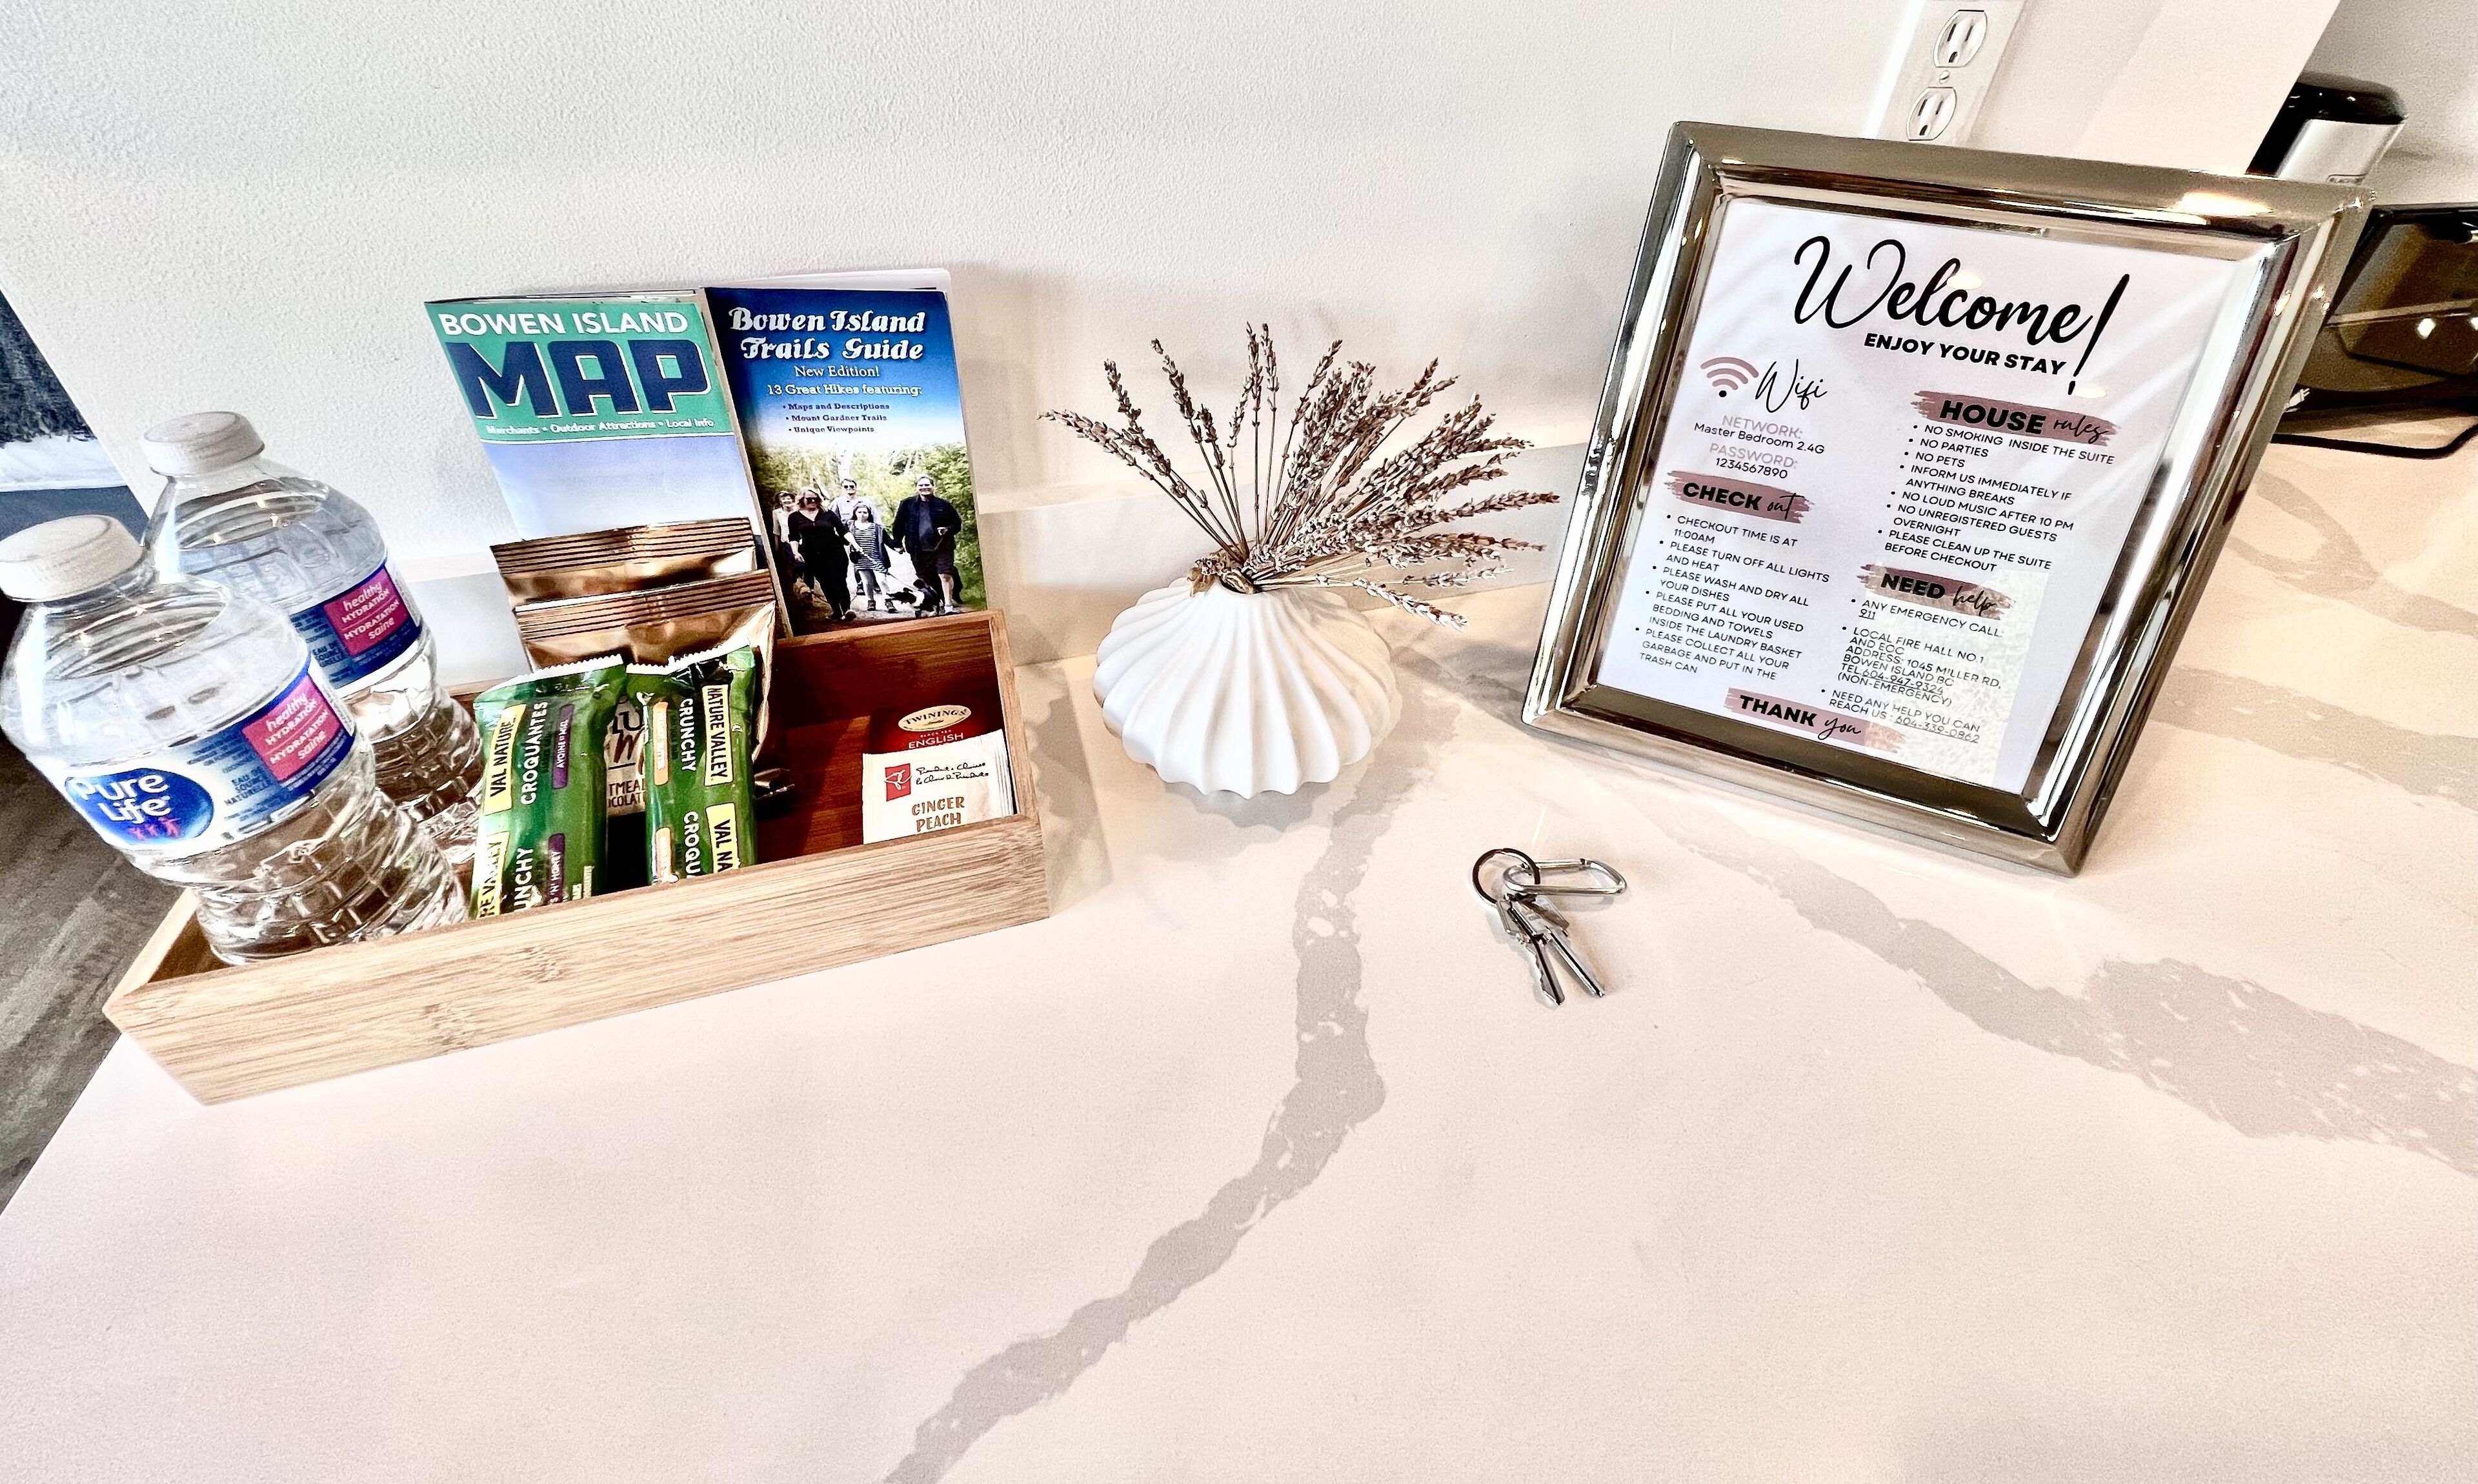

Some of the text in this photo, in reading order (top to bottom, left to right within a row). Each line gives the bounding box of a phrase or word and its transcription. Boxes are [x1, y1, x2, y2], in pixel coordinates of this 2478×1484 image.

[438, 312, 688, 336] BOWEN ISLAND
[729, 307, 925, 332] Bowen Island
[1794, 236, 2130, 396] Welcome!
[740, 337, 923, 359] Trails Guide
[1864, 333, 2067, 376] ENJOY YOUR STAY
[445, 340, 711, 419] MAP
[794, 366, 880, 377] New Edition!
[1755, 359, 1828, 413] Wifi
[768, 385, 923, 397] 13 Great Hikes featuring:
[487, 419, 714, 436] Merchants Outdoor Attractions Local Info
[1722, 415, 1802, 439] NETWORK:
[1940, 399, 2109, 443] HOUSE rules
[1694, 423, 1825, 454] Master Bedroom 2.4G
[1920, 438, 1989, 457] NO PARTIES
[1924, 425, 2115, 465] NO SMOKING INSIDE THE SUITE
[1710, 443, 1798, 469] PASSWORD:
[1717, 458, 1788, 479] 1234567890
[1915, 452, 1966, 467] NO PETS
[1906, 479, 2015, 505] ANYTHING BREAKS
[1911, 465, 2072, 501] INFORM US IMMEDIATELY IF
[1683, 483, 1805, 519] CHECK out
[1902, 491, 2074, 530] NO LOUD MUSIC AFTER 10 PM
[1674, 528, 1715, 544] 11:00AM
[1678, 516, 1798, 547] CHECKOUT TIME IS AT
[1893, 517, 1961, 536] OVERNIGHT
[1898, 504, 2057, 541] NO UNREGISTERED GUESTS
[1666, 555, 1720, 572] AND HEAT
[1671, 542, 1829, 583] PLEASE TURN OFF ALL LIGHTS
[1885, 543, 1997, 572] BEFORE CHECKOUT
[1889, 530, 2051, 570] PLEASE CLEAN UP THE SUITE
[343, 582, 383, 611] healthy
[1660, 580, 1729, 601] YOUR DISHES
[1663, 567, 1808, 606] PLEASE WASH AND DRY ALL
[1880, 573, 1998, 616] NEED help
[342, 588, 390, 623] HYDRATION
[344, 599, 400, 640] HYDRATATION
[1656, 592, 1803, 632] PLEASE PUT ALL YOUR USED
[1859, 609, 1875, 620] 911
[368, 617, 395, 639] saine
[1649, 616, 1802, 659] INSIDE THE LAUNDRY BASKET
[1653, 605, 1773, 639] BEDDING AND TOWELS
[1639, 652, 1697, 673] TRASH CAN
[1642, 641, 1777, 680] GARBAGE AND PUT IN THE
[1646, 628, 1789, 670] PLEASE COLLECT ALL YOUR
[1838, 672, 1952, 707] (NON-EMERGENCY)
[265, 699, 317, 745] HYDRATION
[266, 693, 308, 732] healthy
[905, 708, 967, 725] TWININGS
[1740, 695, 1862, 740] THANK you
[1829, 699, 1868, 715] REACH
[1872, 710, 1887, 719] US
[1833, 690, 1980, 732] NEED ANY HELP YOU CAN
[270, 709, 328, 765] HYDRATATION
[298, 730, 327, 759] saine
[679, 698, 696, 772] CRUNCHY
[707, 688, 728, 778] NATURE VALLEY
[909, 732, 963, 748] ENGLISH
[490, 721, 514, 796] VAL NATURE
[521, 701, 548, 805] CROQUANTES
[68, 774, 170, 800] Pure
[99, 797, 170, 824] Life
[911, 796, 965, 816] GINGER
[714, 819, 732, 848] VAL
[916, 812, 961, 832] PEACH
